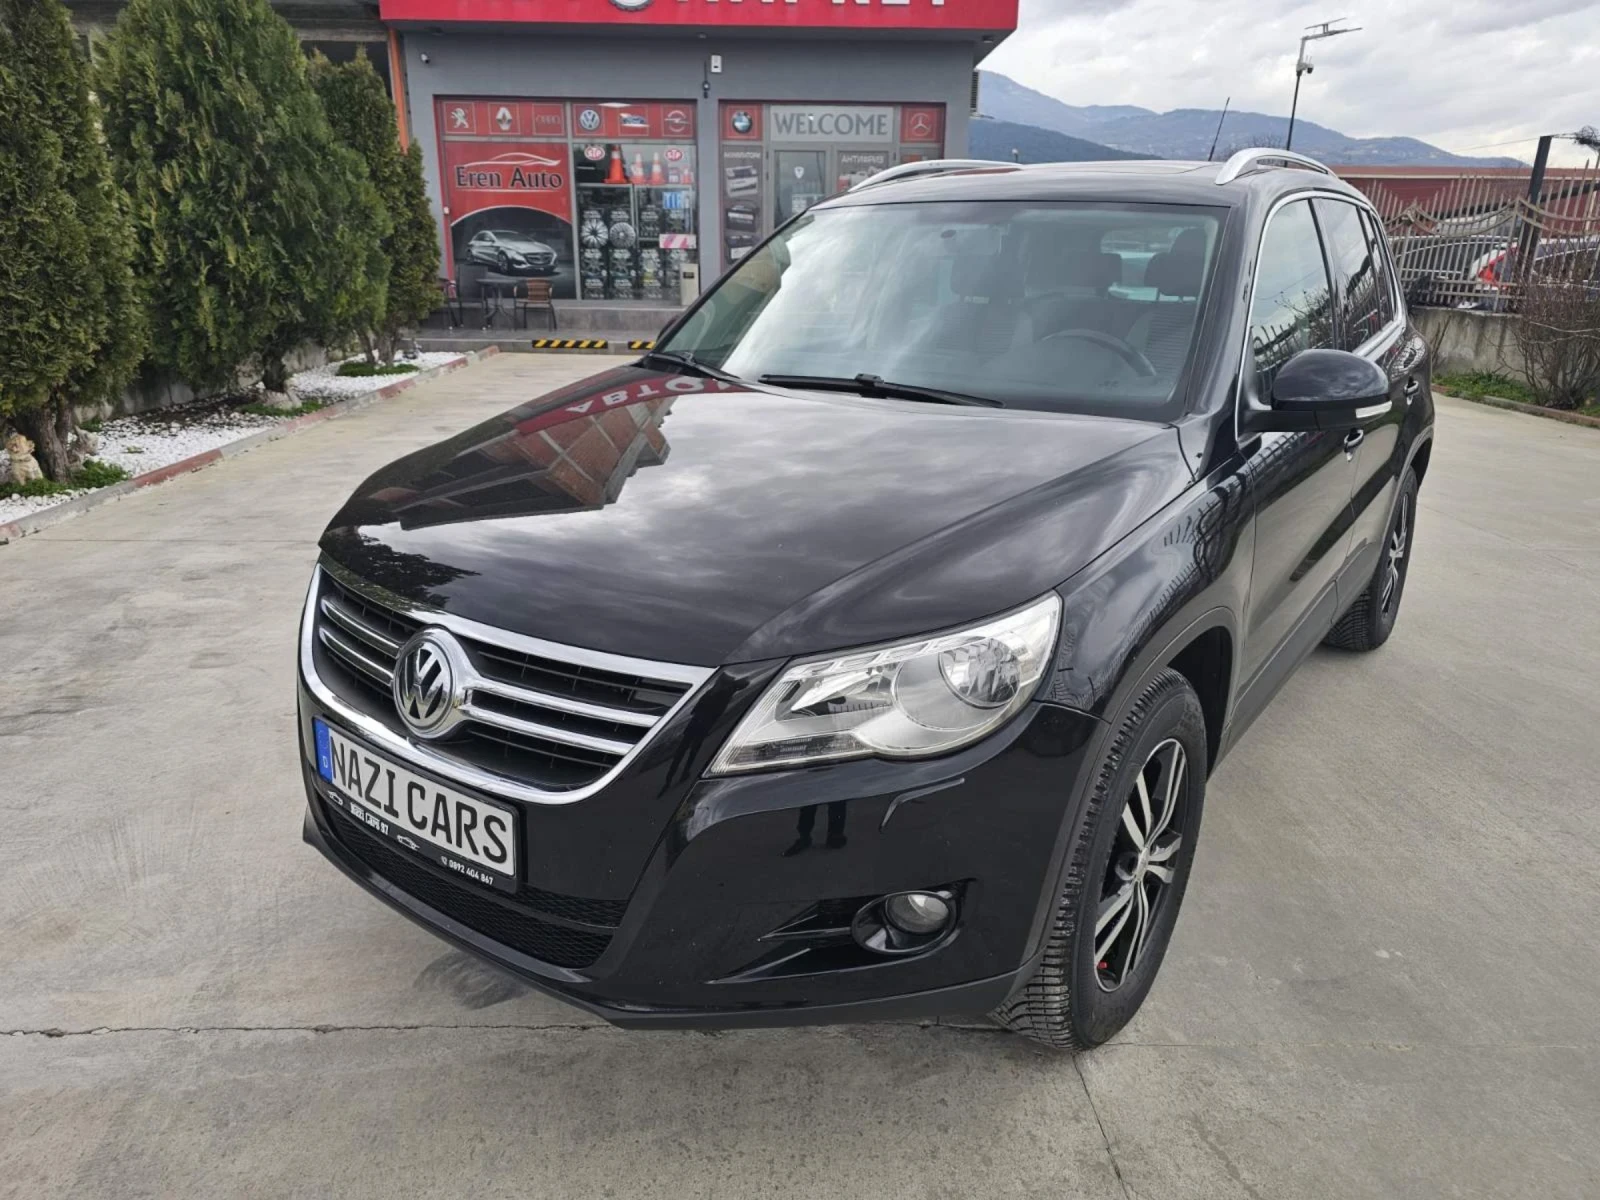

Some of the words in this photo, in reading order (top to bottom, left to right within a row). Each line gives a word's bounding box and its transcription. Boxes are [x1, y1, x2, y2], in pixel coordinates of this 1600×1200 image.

[774, 112, 888, 136] WELCOME
[456, 166, 501, 187] Eren
[511, 167, 562, 188] Auto
[330, 735, 399, 819] NAZI
[407, 781, 508, 864] CARS
[448, 859, 465, 874] 0892
[466, 867, 480, 880] 404
